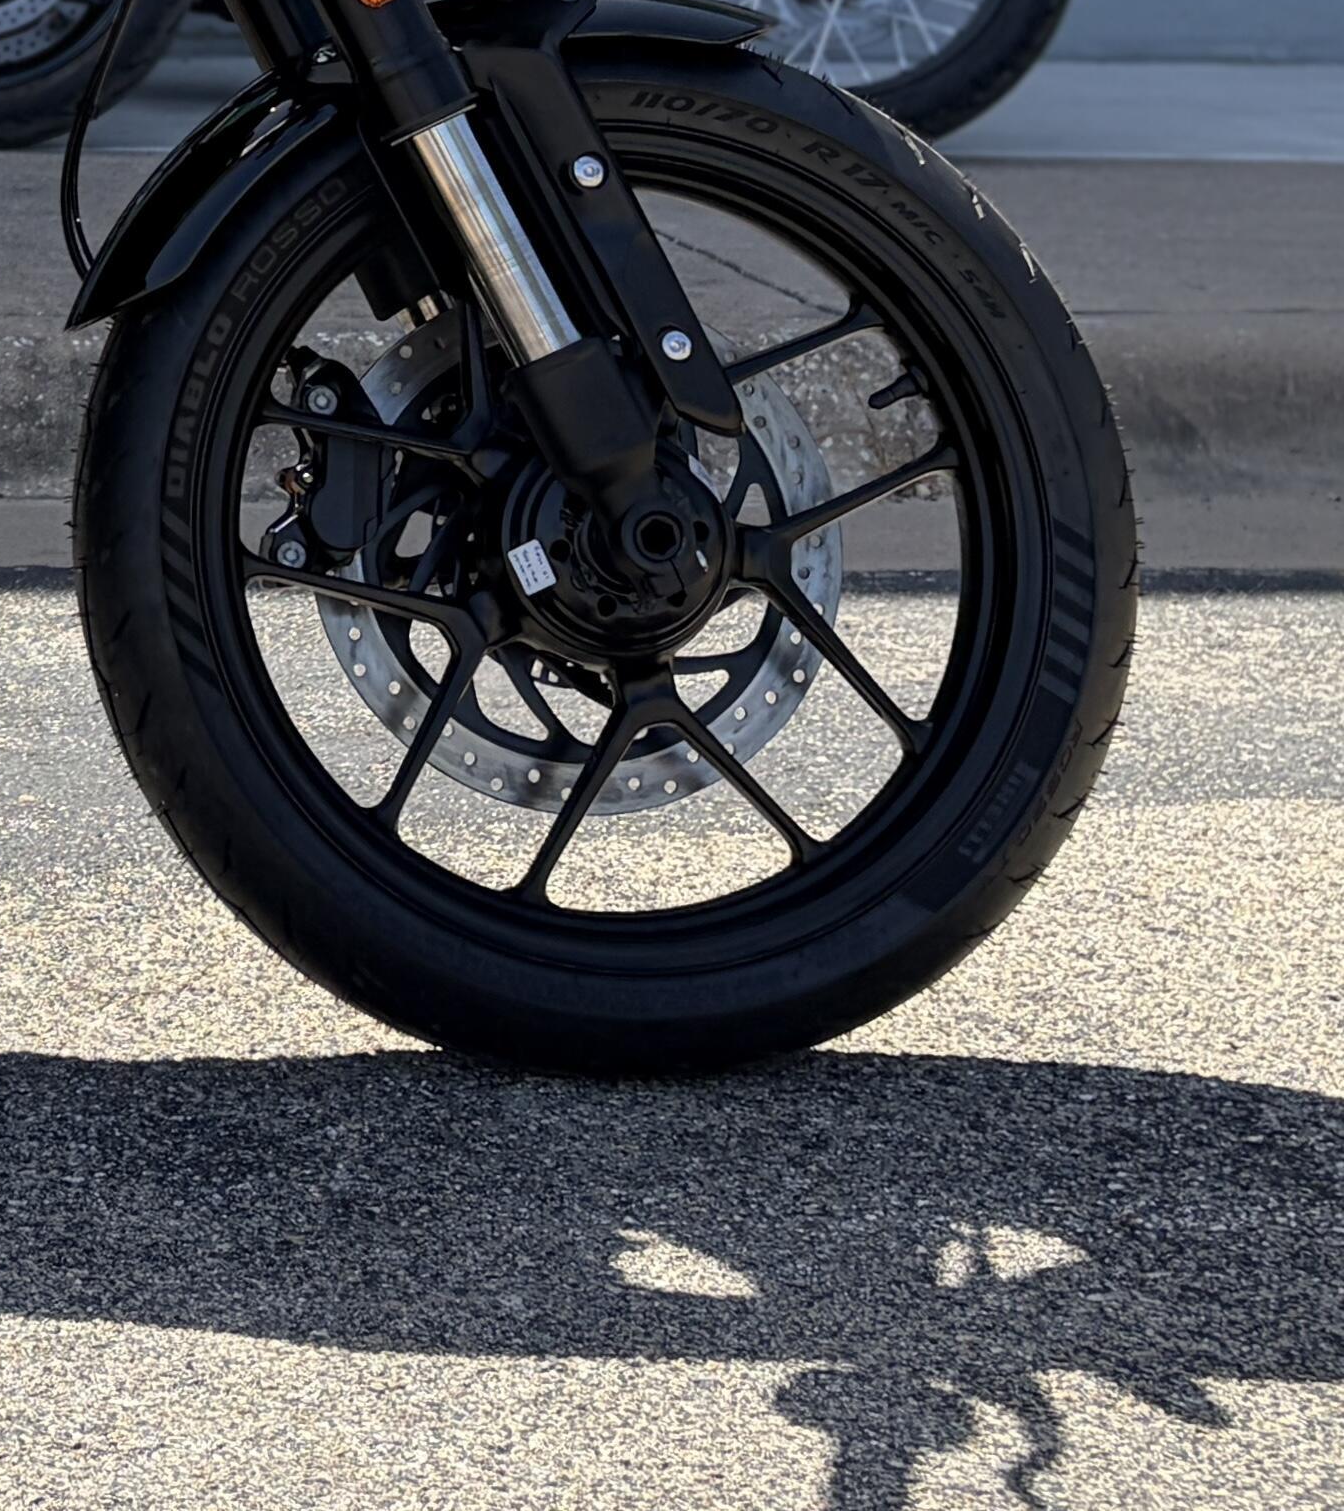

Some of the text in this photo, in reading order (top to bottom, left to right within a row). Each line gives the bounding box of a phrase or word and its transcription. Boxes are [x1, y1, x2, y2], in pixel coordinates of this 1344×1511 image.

[628, 90, 779, 136] 110/70
[164, 176, 348, 499] DIABLO ROSSO
